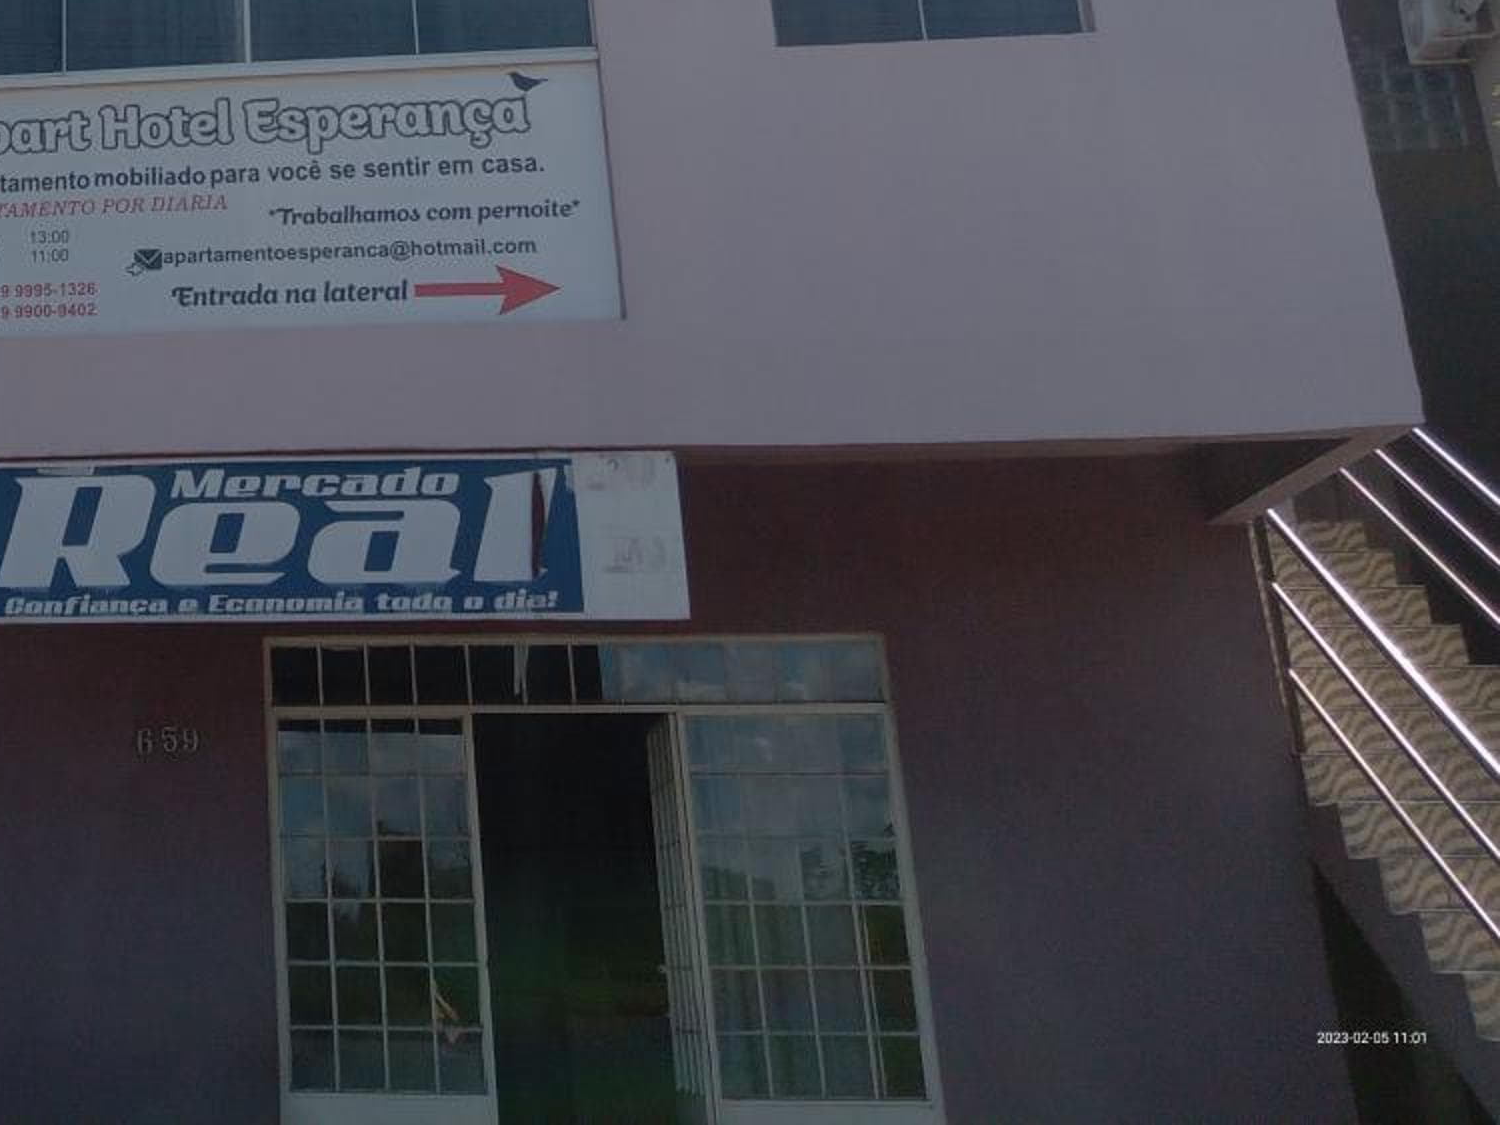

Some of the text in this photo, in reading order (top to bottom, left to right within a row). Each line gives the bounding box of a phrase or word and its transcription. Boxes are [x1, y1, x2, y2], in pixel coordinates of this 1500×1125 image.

[99, 96, 235, 150] Hotel
[243, 95, 531, 154] Esperança
[94, 166, 206, 190] mobiliado
[209, 166, 261, 189] para
[268, 159, 322, 182] você
[329, 164, 357, 181] se
[363, 156, 431, 179] sentir
[438, 158, 474, 176] em
[481, 154, 546, 175] casa.
[101, 197, 146, 216] POR
[150, 194, 229, 213] DIARIA
[426, 204, 472, 222] com
[30, 229, 70, 245] 13:00
[31, 248, 69, 264] 11:00
[171, 280, 408, 307] Entrada na lateral
[170, 466, 460, 500] Mercado
[3, 589, 559, 618] Confiança e Economia todo o dia!
[136, 725, 199, 756] 659
